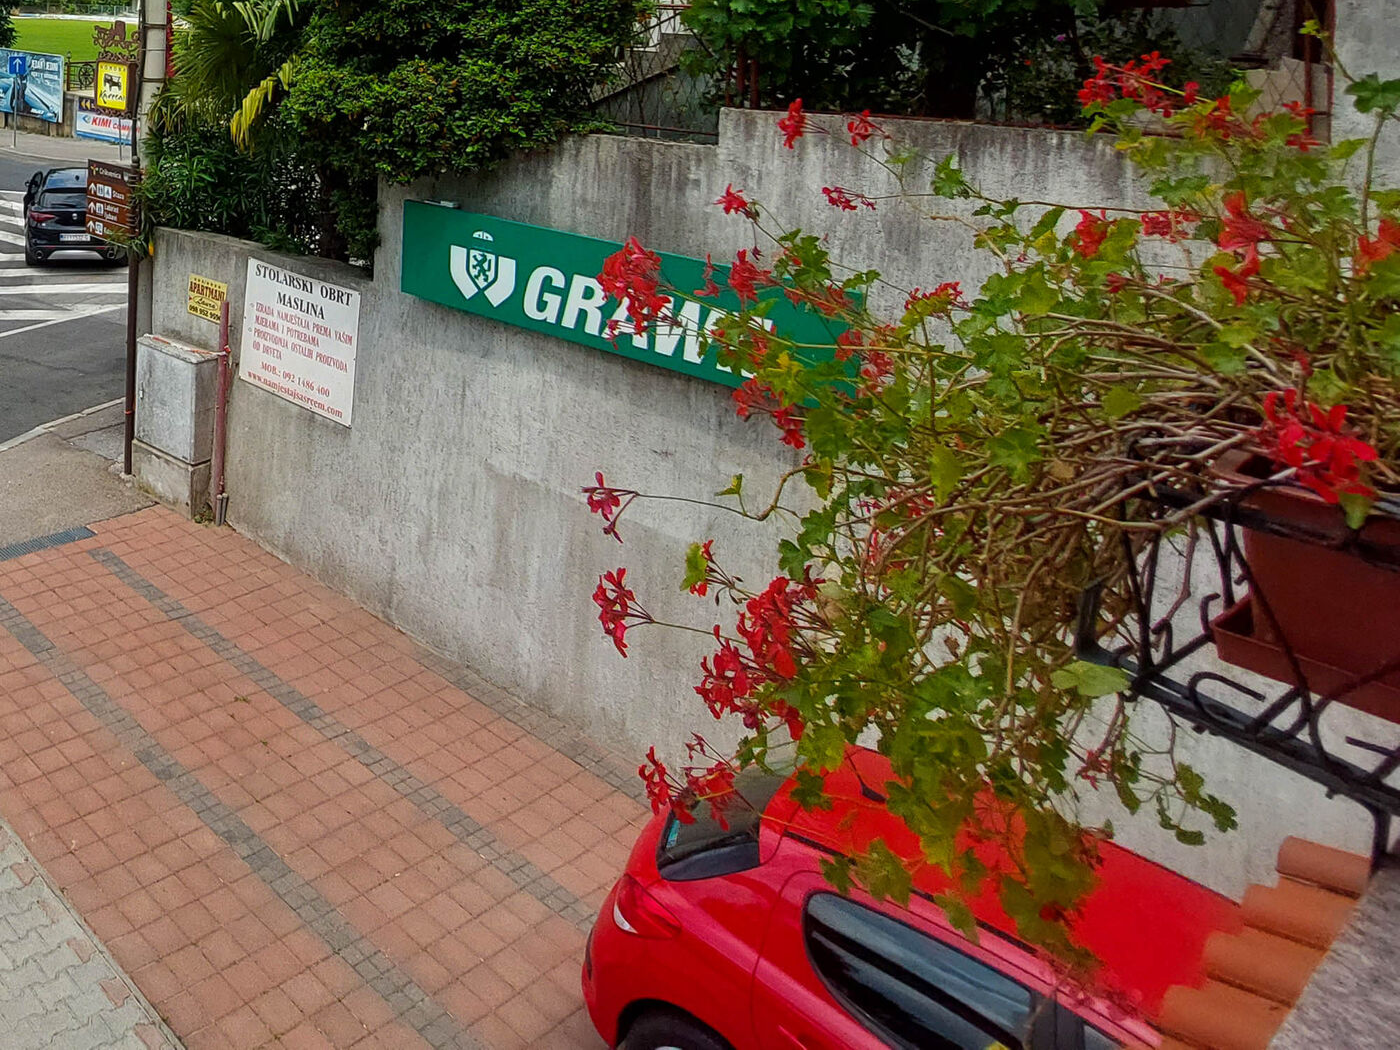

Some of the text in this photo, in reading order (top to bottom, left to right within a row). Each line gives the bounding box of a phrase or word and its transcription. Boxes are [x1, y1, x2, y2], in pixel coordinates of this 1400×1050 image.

[91, 116, 112, 128] KIMI
[189, 281, 225, 301] APARTMANI
[255, 263, 352, 306] STOLARSKI OBRT
[276, 291, 325, 320] MASLINA
[255, 302, 353, 346] IZRADA NAMJEŠTAJA PREMA VAŠIM
[255, 315, 279, 333] MJERAMA
[286, 326, 319, 347] POTREBAMA
[252, 340, 282, 361] OD DRVETA
[254, 328, 289, 350] PROIZVODNJA
[290, 342, 314, 359] OSTALIH
[282, 370, 295, 383] 092
[297, 377, 315, 391] 1486
[316, 385, 330, 398] 400
